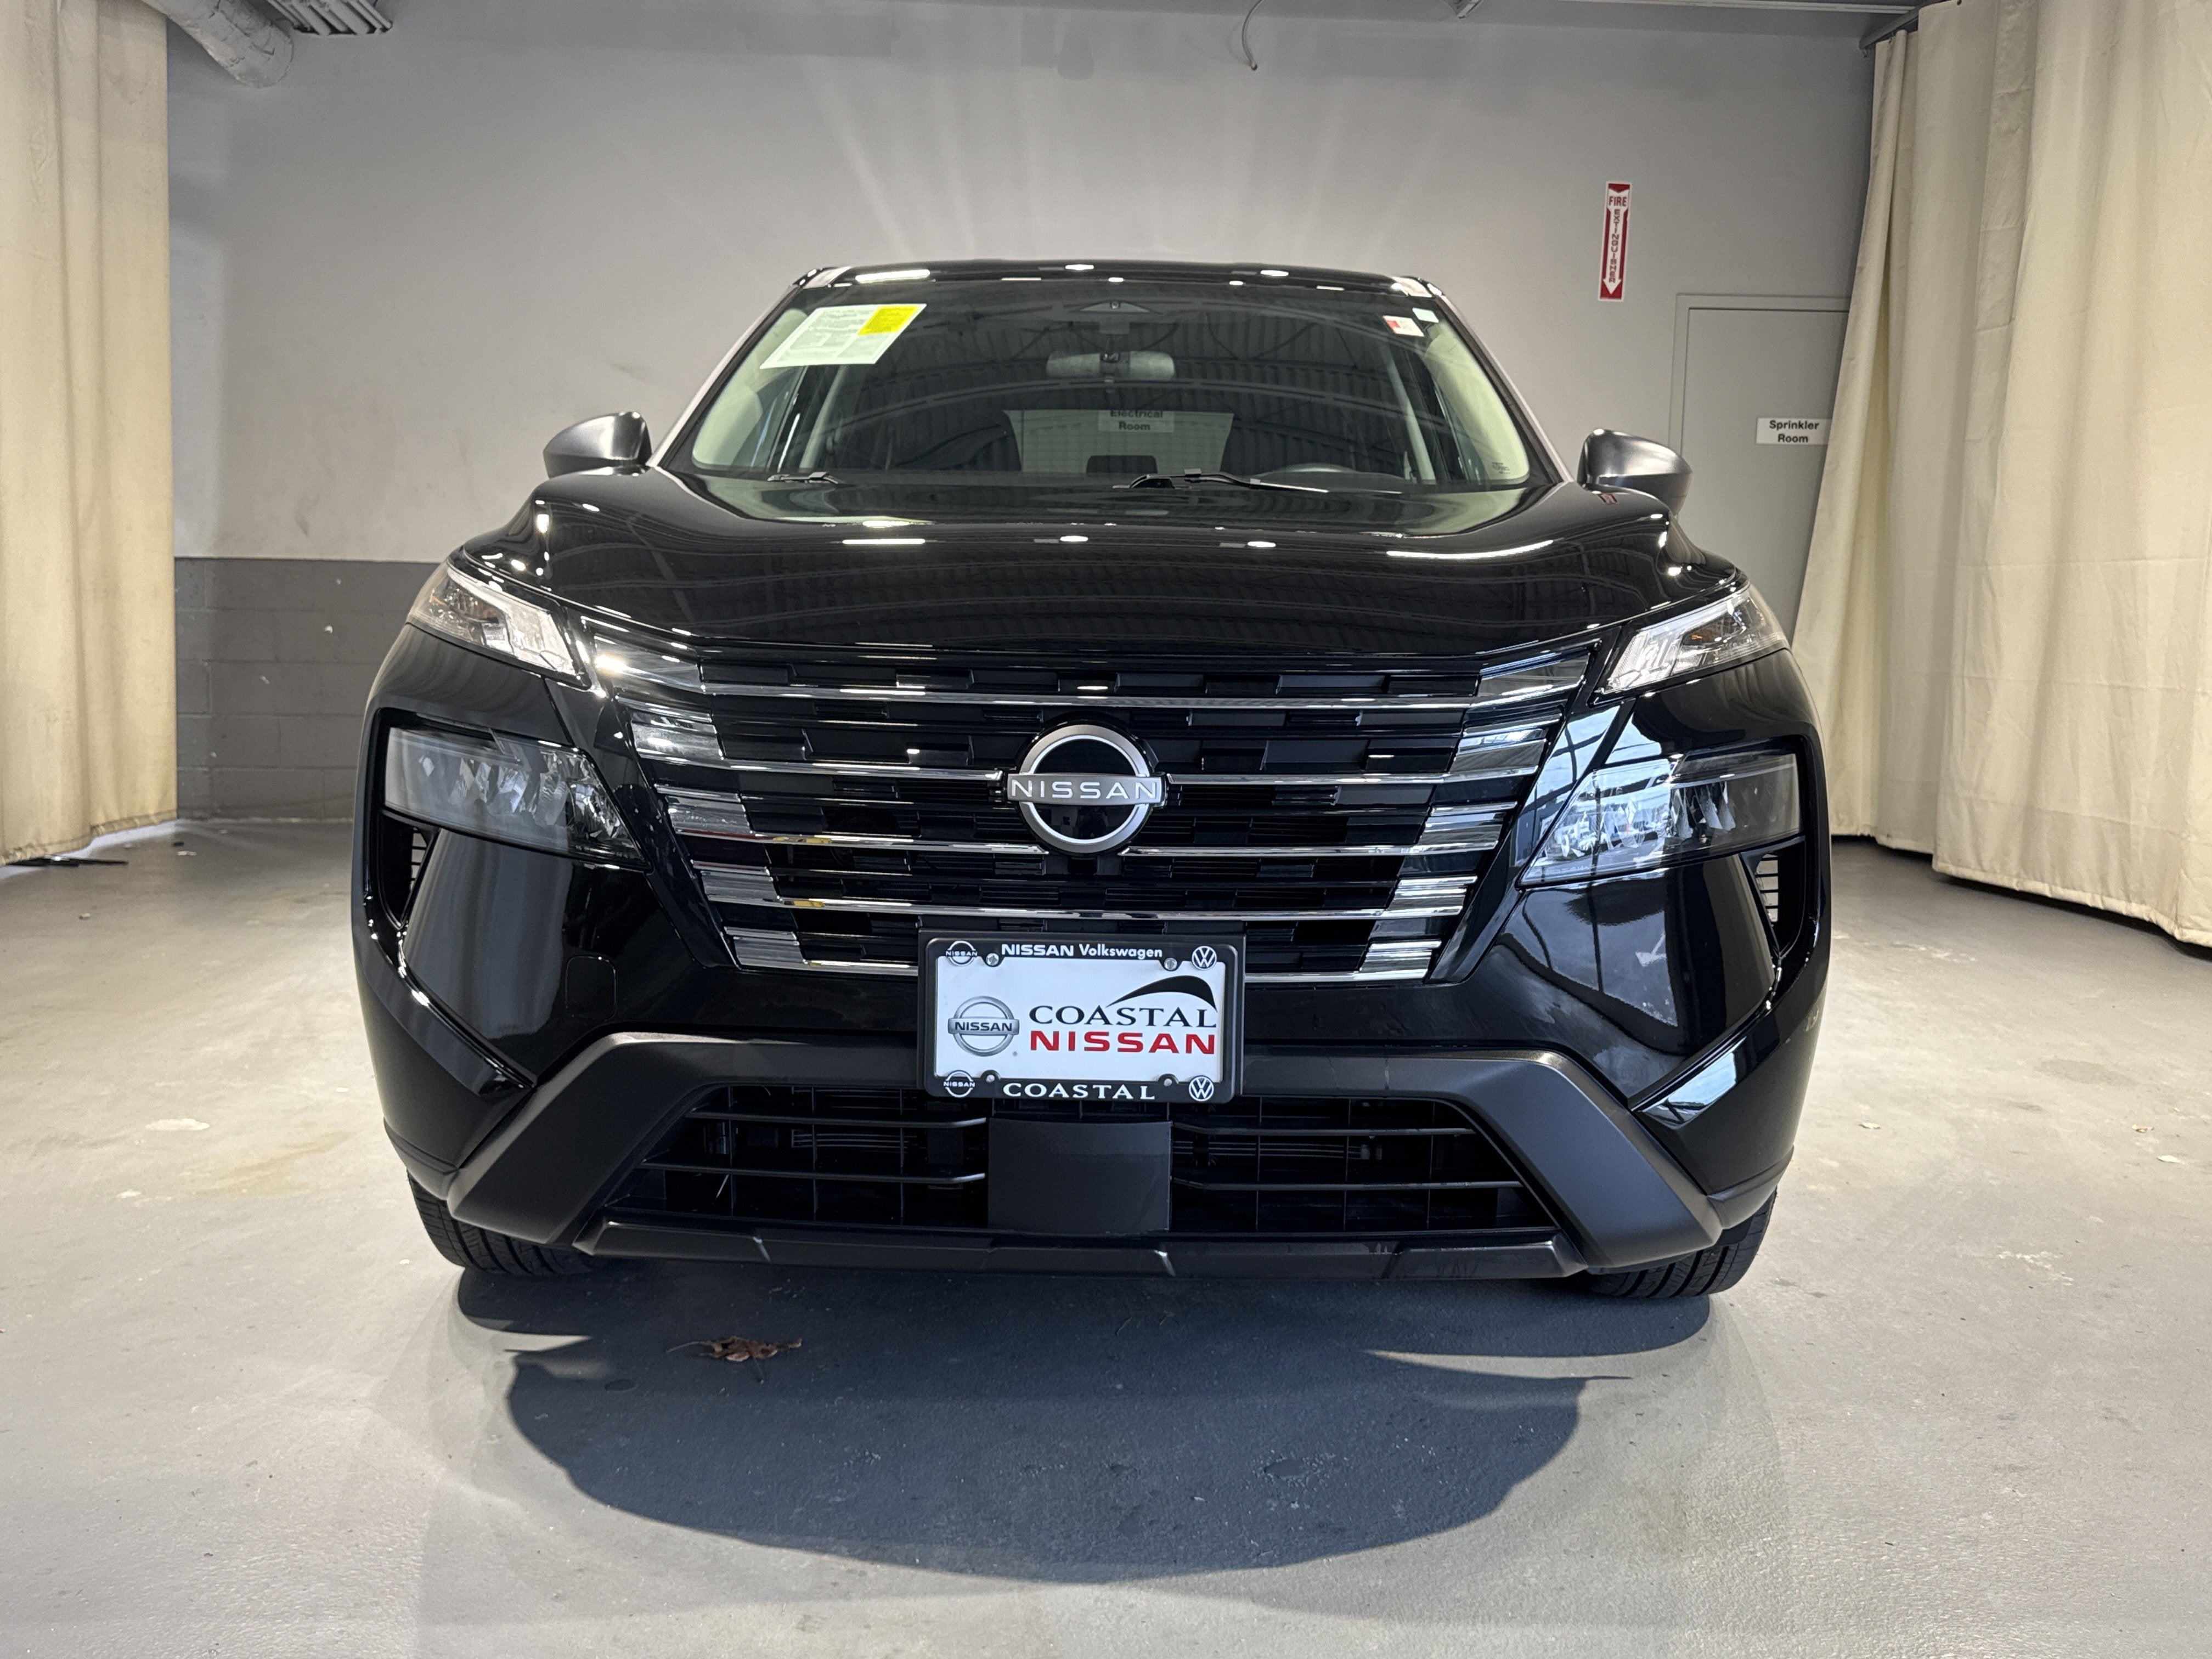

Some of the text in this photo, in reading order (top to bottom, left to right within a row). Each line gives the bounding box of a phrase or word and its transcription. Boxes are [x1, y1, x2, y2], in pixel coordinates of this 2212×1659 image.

[1609, 196, 1627, 207] FIRE
[1609, 209, 1621, 283] EXTINGUISHER
[1110, 409, 1163, 417] Electrical
[1119, 421, 1150, 430] Room
[1769, 420, 1820, 431] Sprinkler
[1778, 433, 1809, 443] Room
[1011, 779, 1156, 799] NISSAN
[1001, 943, 1163, 960] NISSAN Volkswagen
[1029, 1005, 1217, 1028] COASTAL
[955, 1022, 1013, 1032] NISSAN
[1030, 1030, 1215, 1055] NISSAN
[1003, 1082, 1155, 1100] COASTAL
